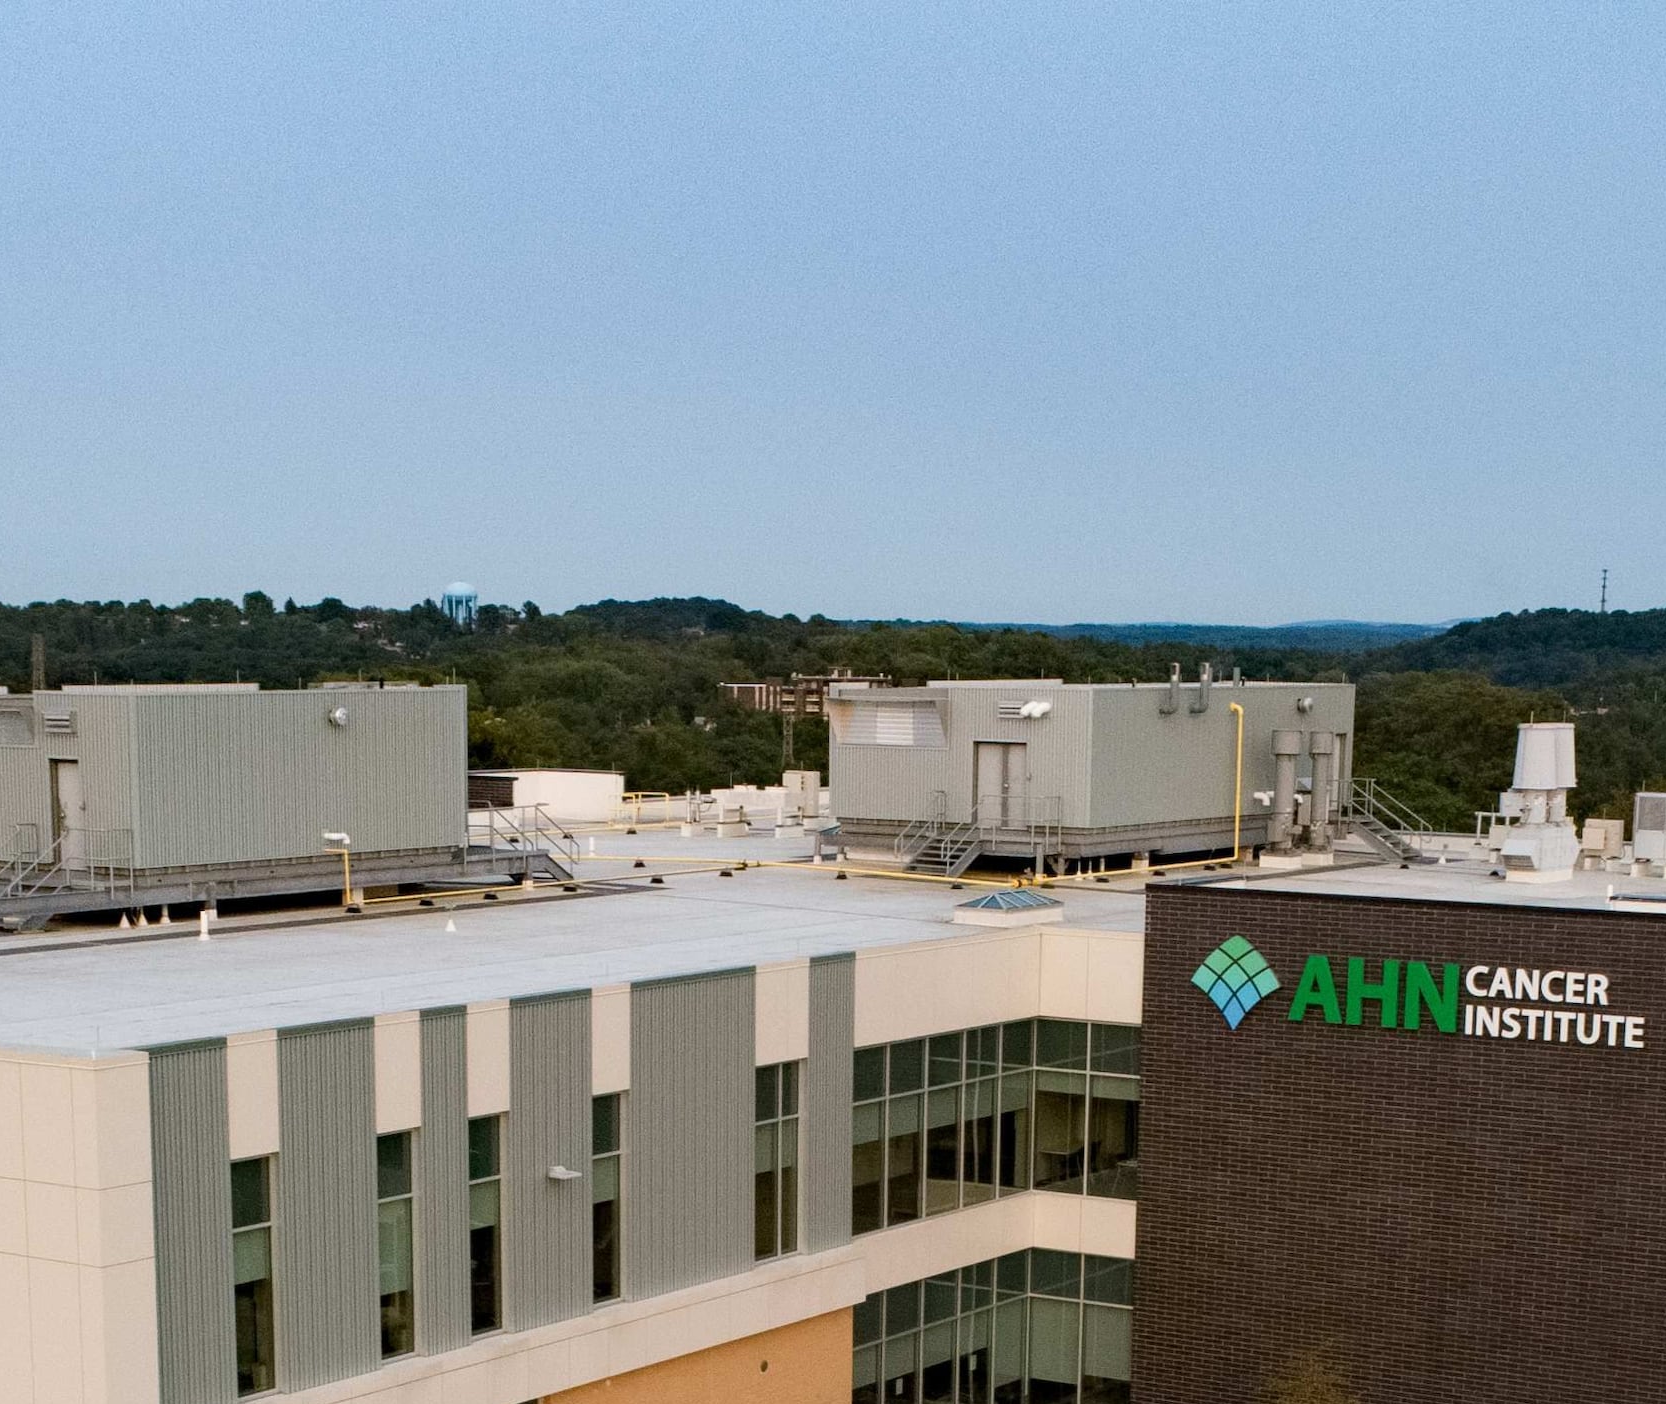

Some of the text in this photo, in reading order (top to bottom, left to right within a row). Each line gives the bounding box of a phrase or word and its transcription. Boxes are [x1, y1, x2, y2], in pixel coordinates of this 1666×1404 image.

[1288, 955, 1460, 1033] AHN
[1465, 965, 1609, 1005] CANCER
[1464, 1006, 1645, 1048] INSTITUTE
